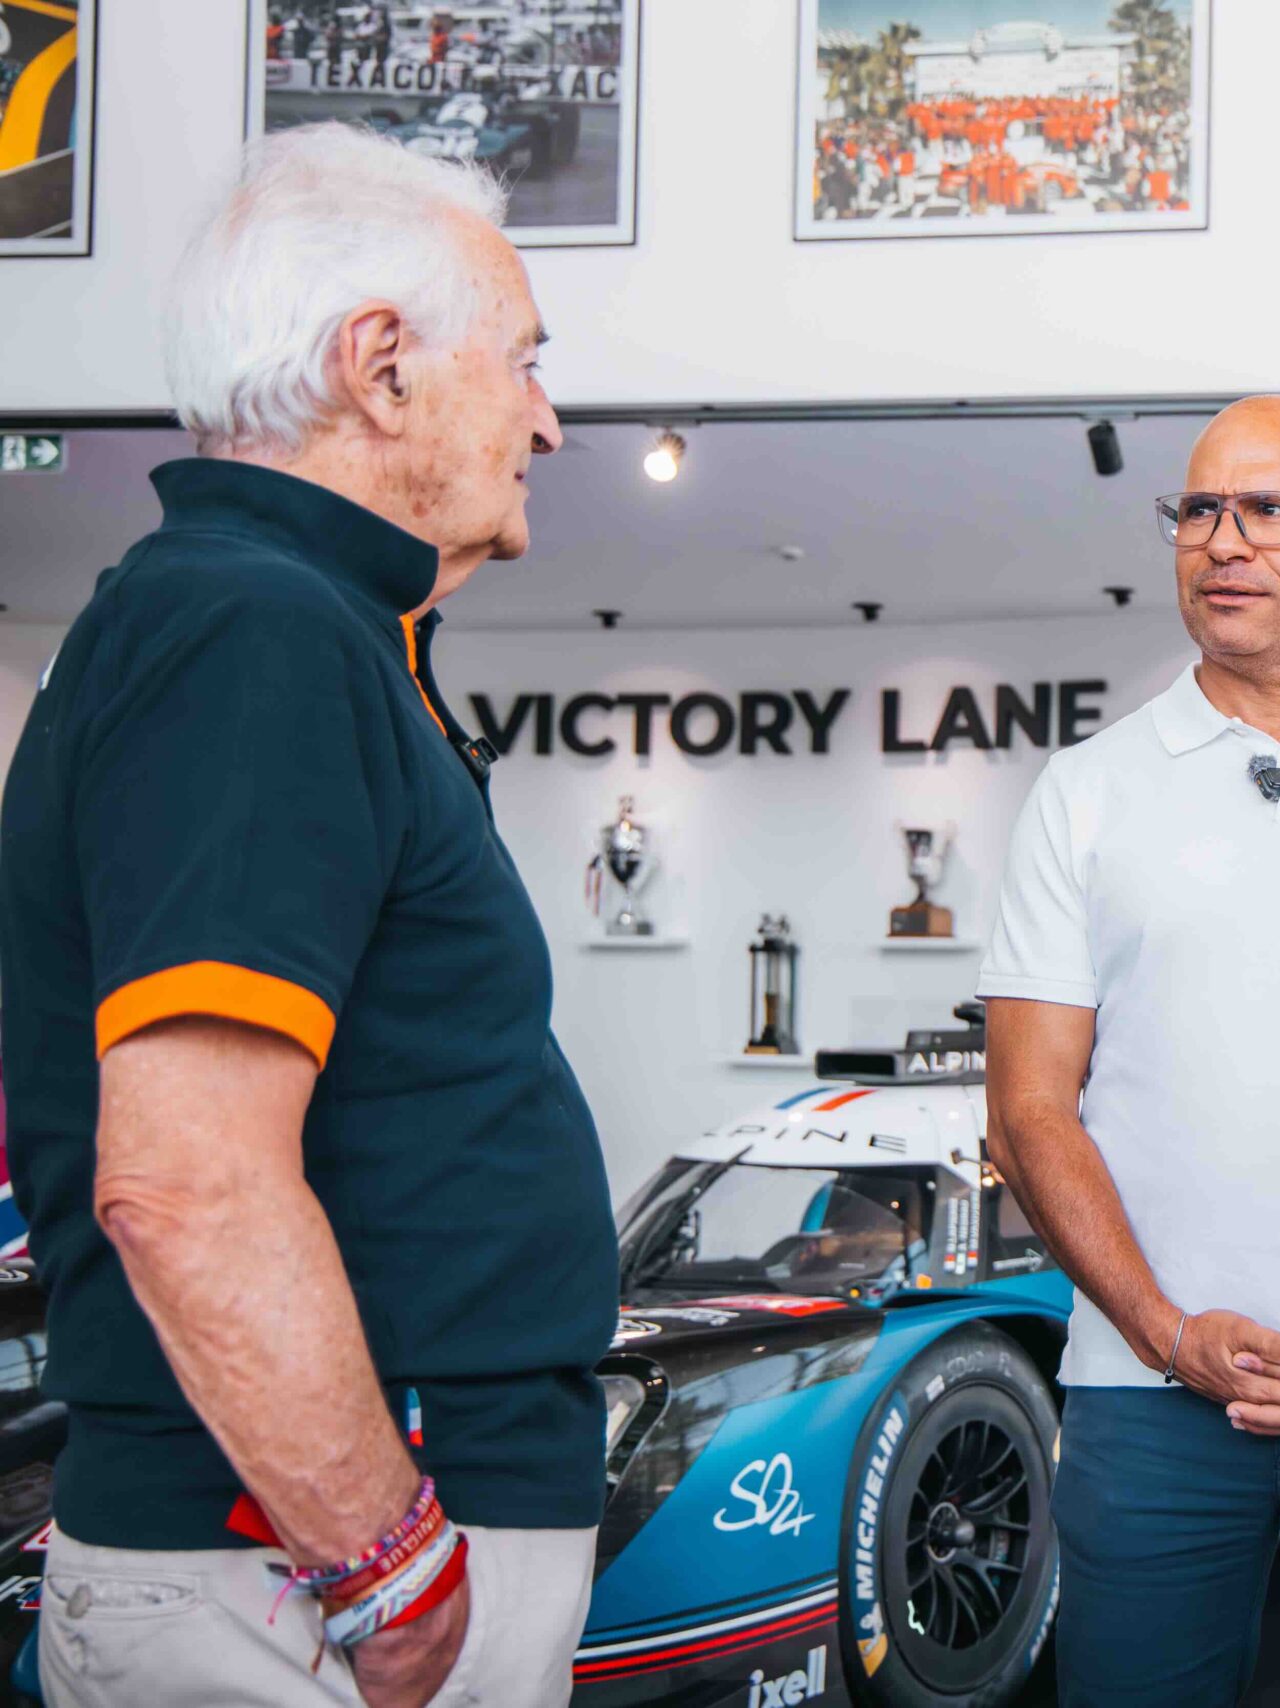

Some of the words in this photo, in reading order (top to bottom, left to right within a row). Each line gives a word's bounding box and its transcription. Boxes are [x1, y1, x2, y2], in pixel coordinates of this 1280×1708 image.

[308, 62, 434, 92] TEXACO
[467, 688, 851, 757] VICTORY
[881, 680, 1108, 756] LANE
[855, 1407, 904, 1599] MICHELIN
[747, 1645, 828, 1708] ixell
